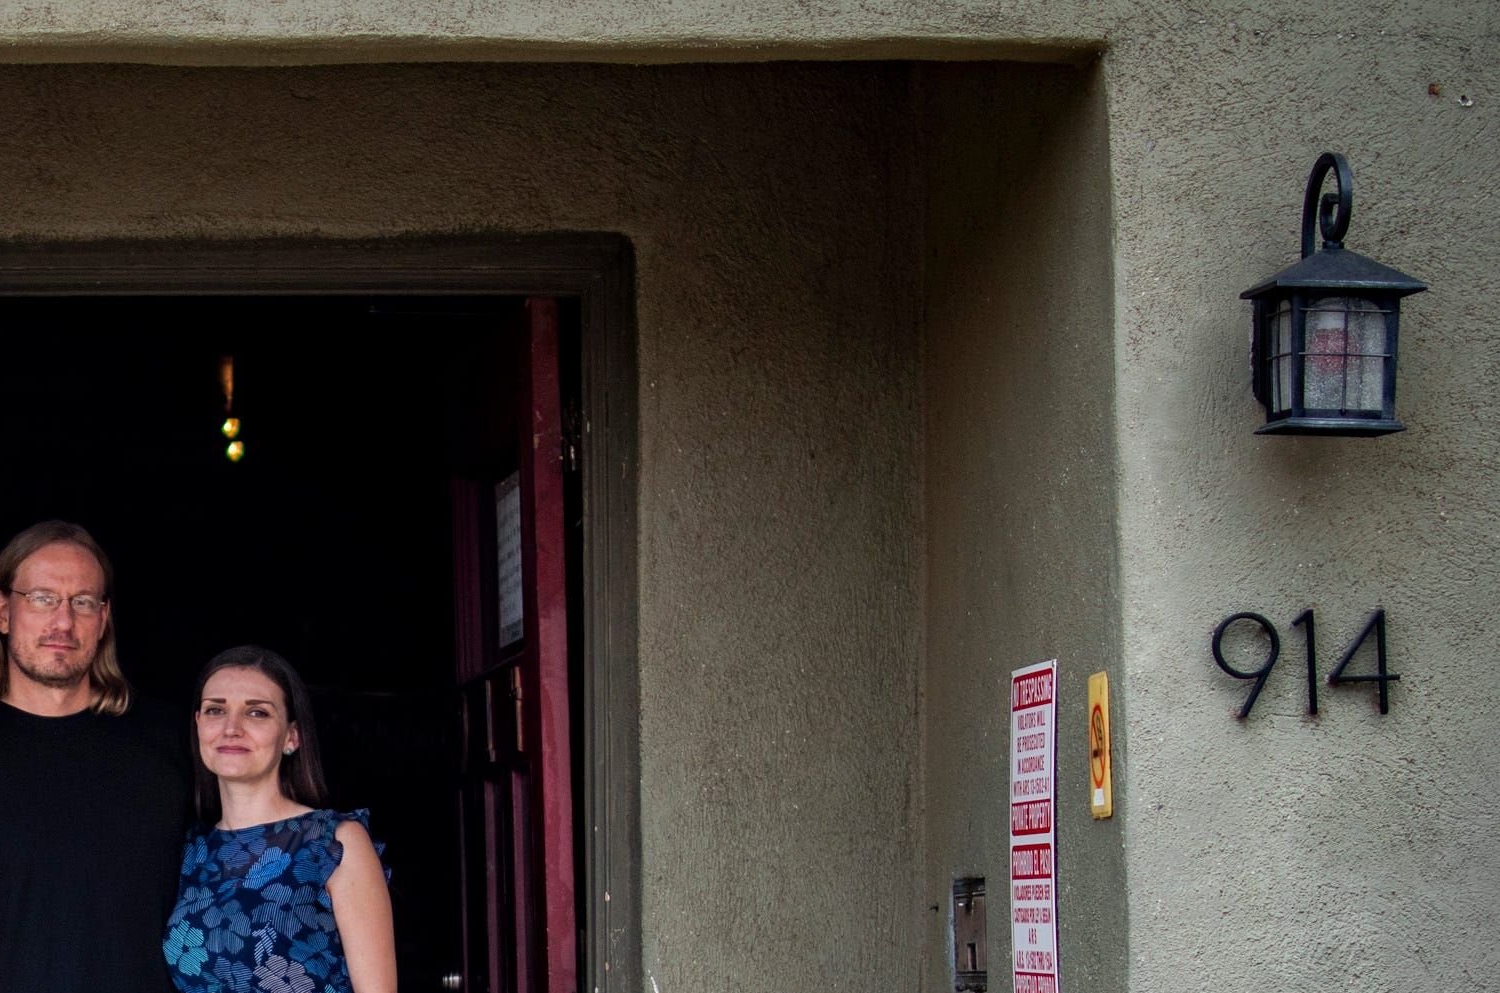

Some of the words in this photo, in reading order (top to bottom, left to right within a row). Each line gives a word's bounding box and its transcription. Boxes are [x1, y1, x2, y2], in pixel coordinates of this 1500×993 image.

[1212, 609, 1400, 718] 914
[1019, 673, 1052, 706] TRESPASSING
[1012, 804, 1028, 831] PRIVATE
[1028, 802, 1050, 829] PROPERTY
